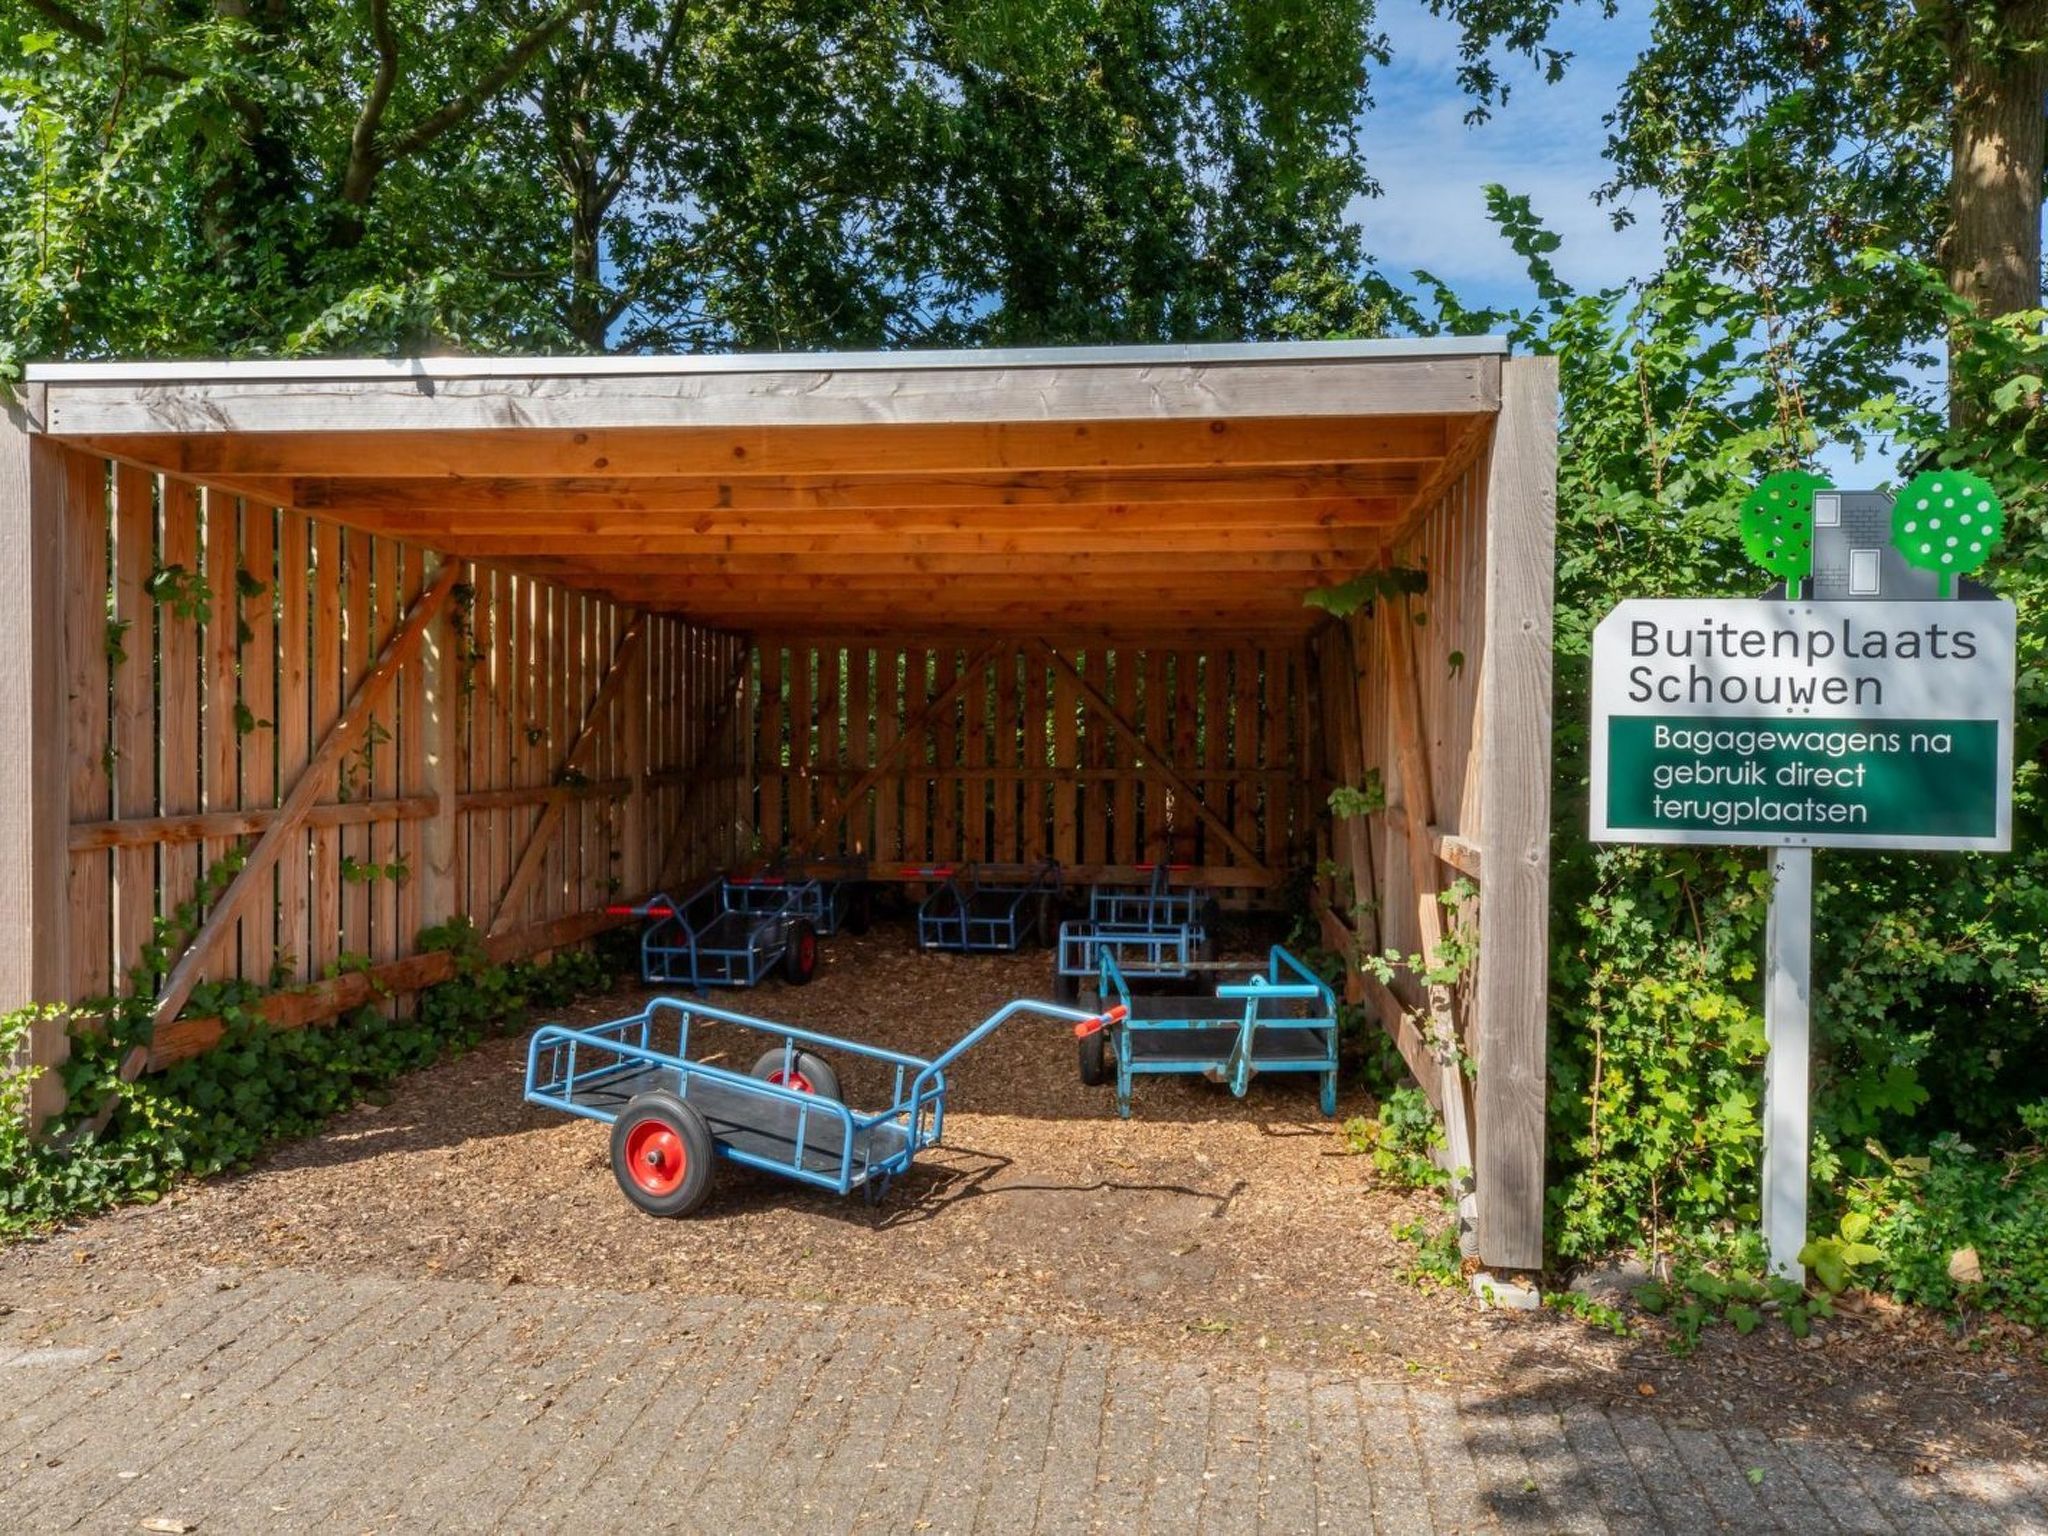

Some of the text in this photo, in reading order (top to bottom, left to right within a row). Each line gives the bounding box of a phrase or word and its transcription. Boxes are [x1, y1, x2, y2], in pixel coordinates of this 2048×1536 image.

[1631, 618, 1977, 666] Buitenplaats
[1628, 664, 1882, 705] Schouwen
[1654, 725, 1952, 757] Bagagewagens na
[1653, 760, 1867, 789] gebruik direct
[1653, 795, 1868, 825] terugplaatsen
